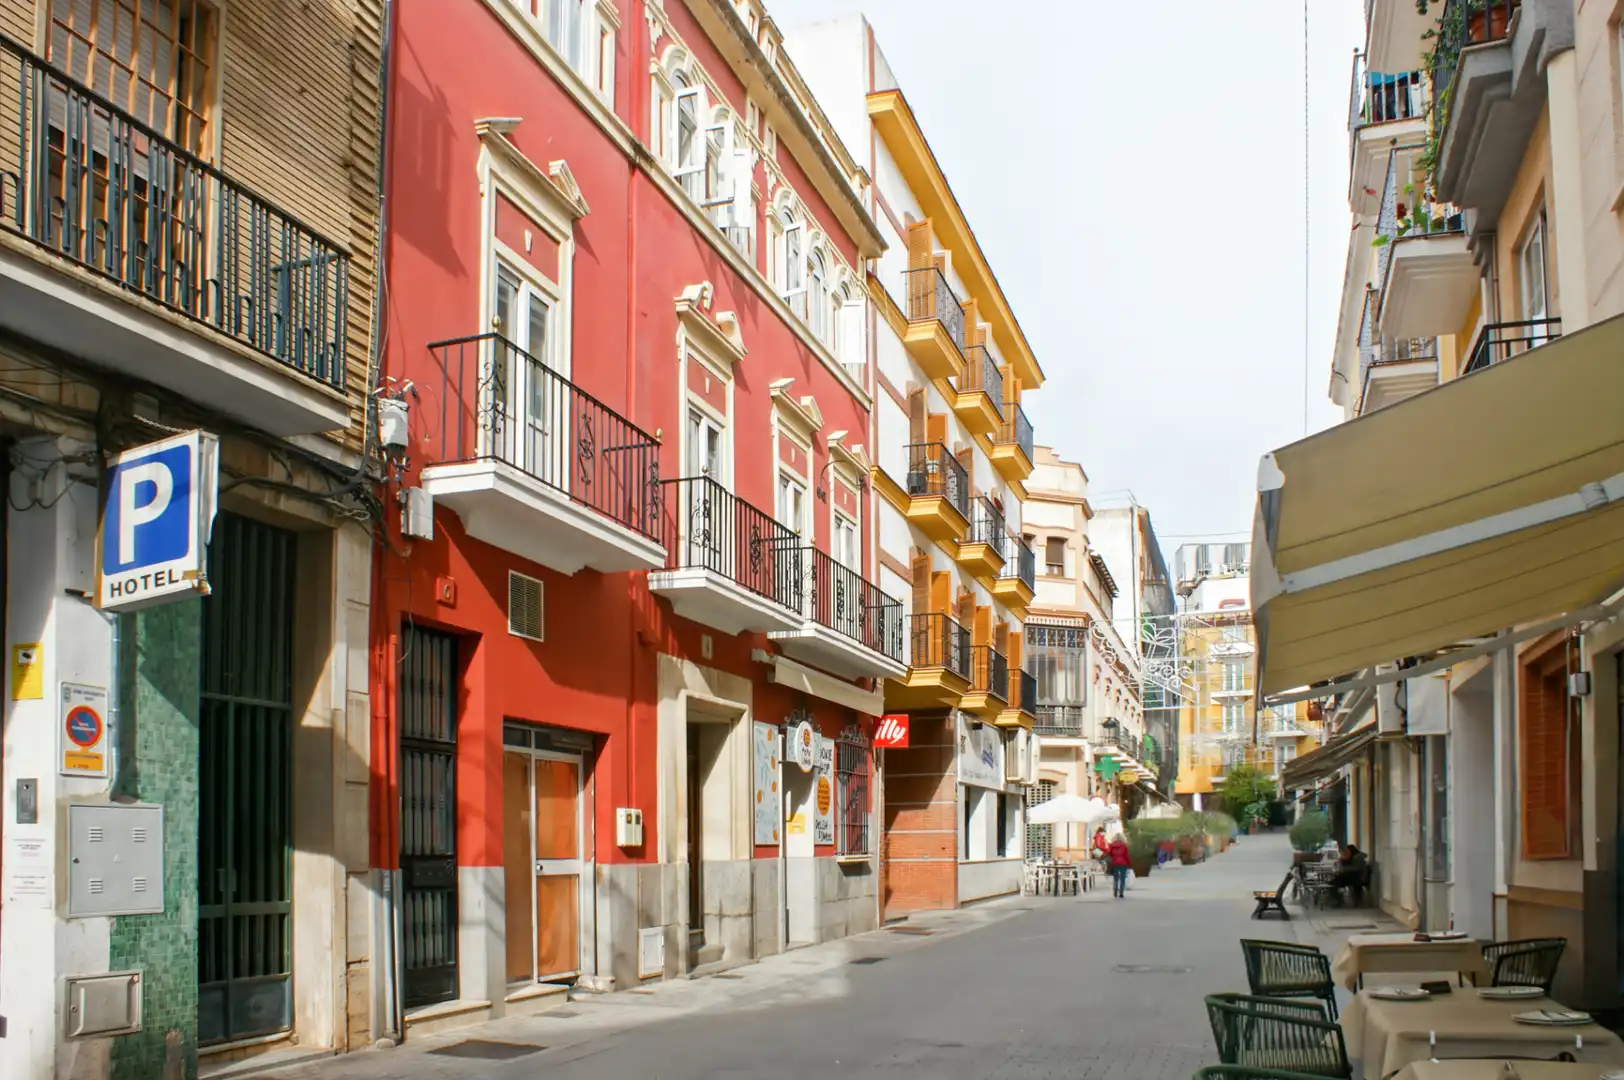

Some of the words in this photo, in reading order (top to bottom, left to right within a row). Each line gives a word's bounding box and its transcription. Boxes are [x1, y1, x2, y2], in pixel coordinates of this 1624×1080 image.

[119, 462, 173, 565] P
[110, 569, 180, 598] HOTEL
[875, 718, 906, 745] illy
